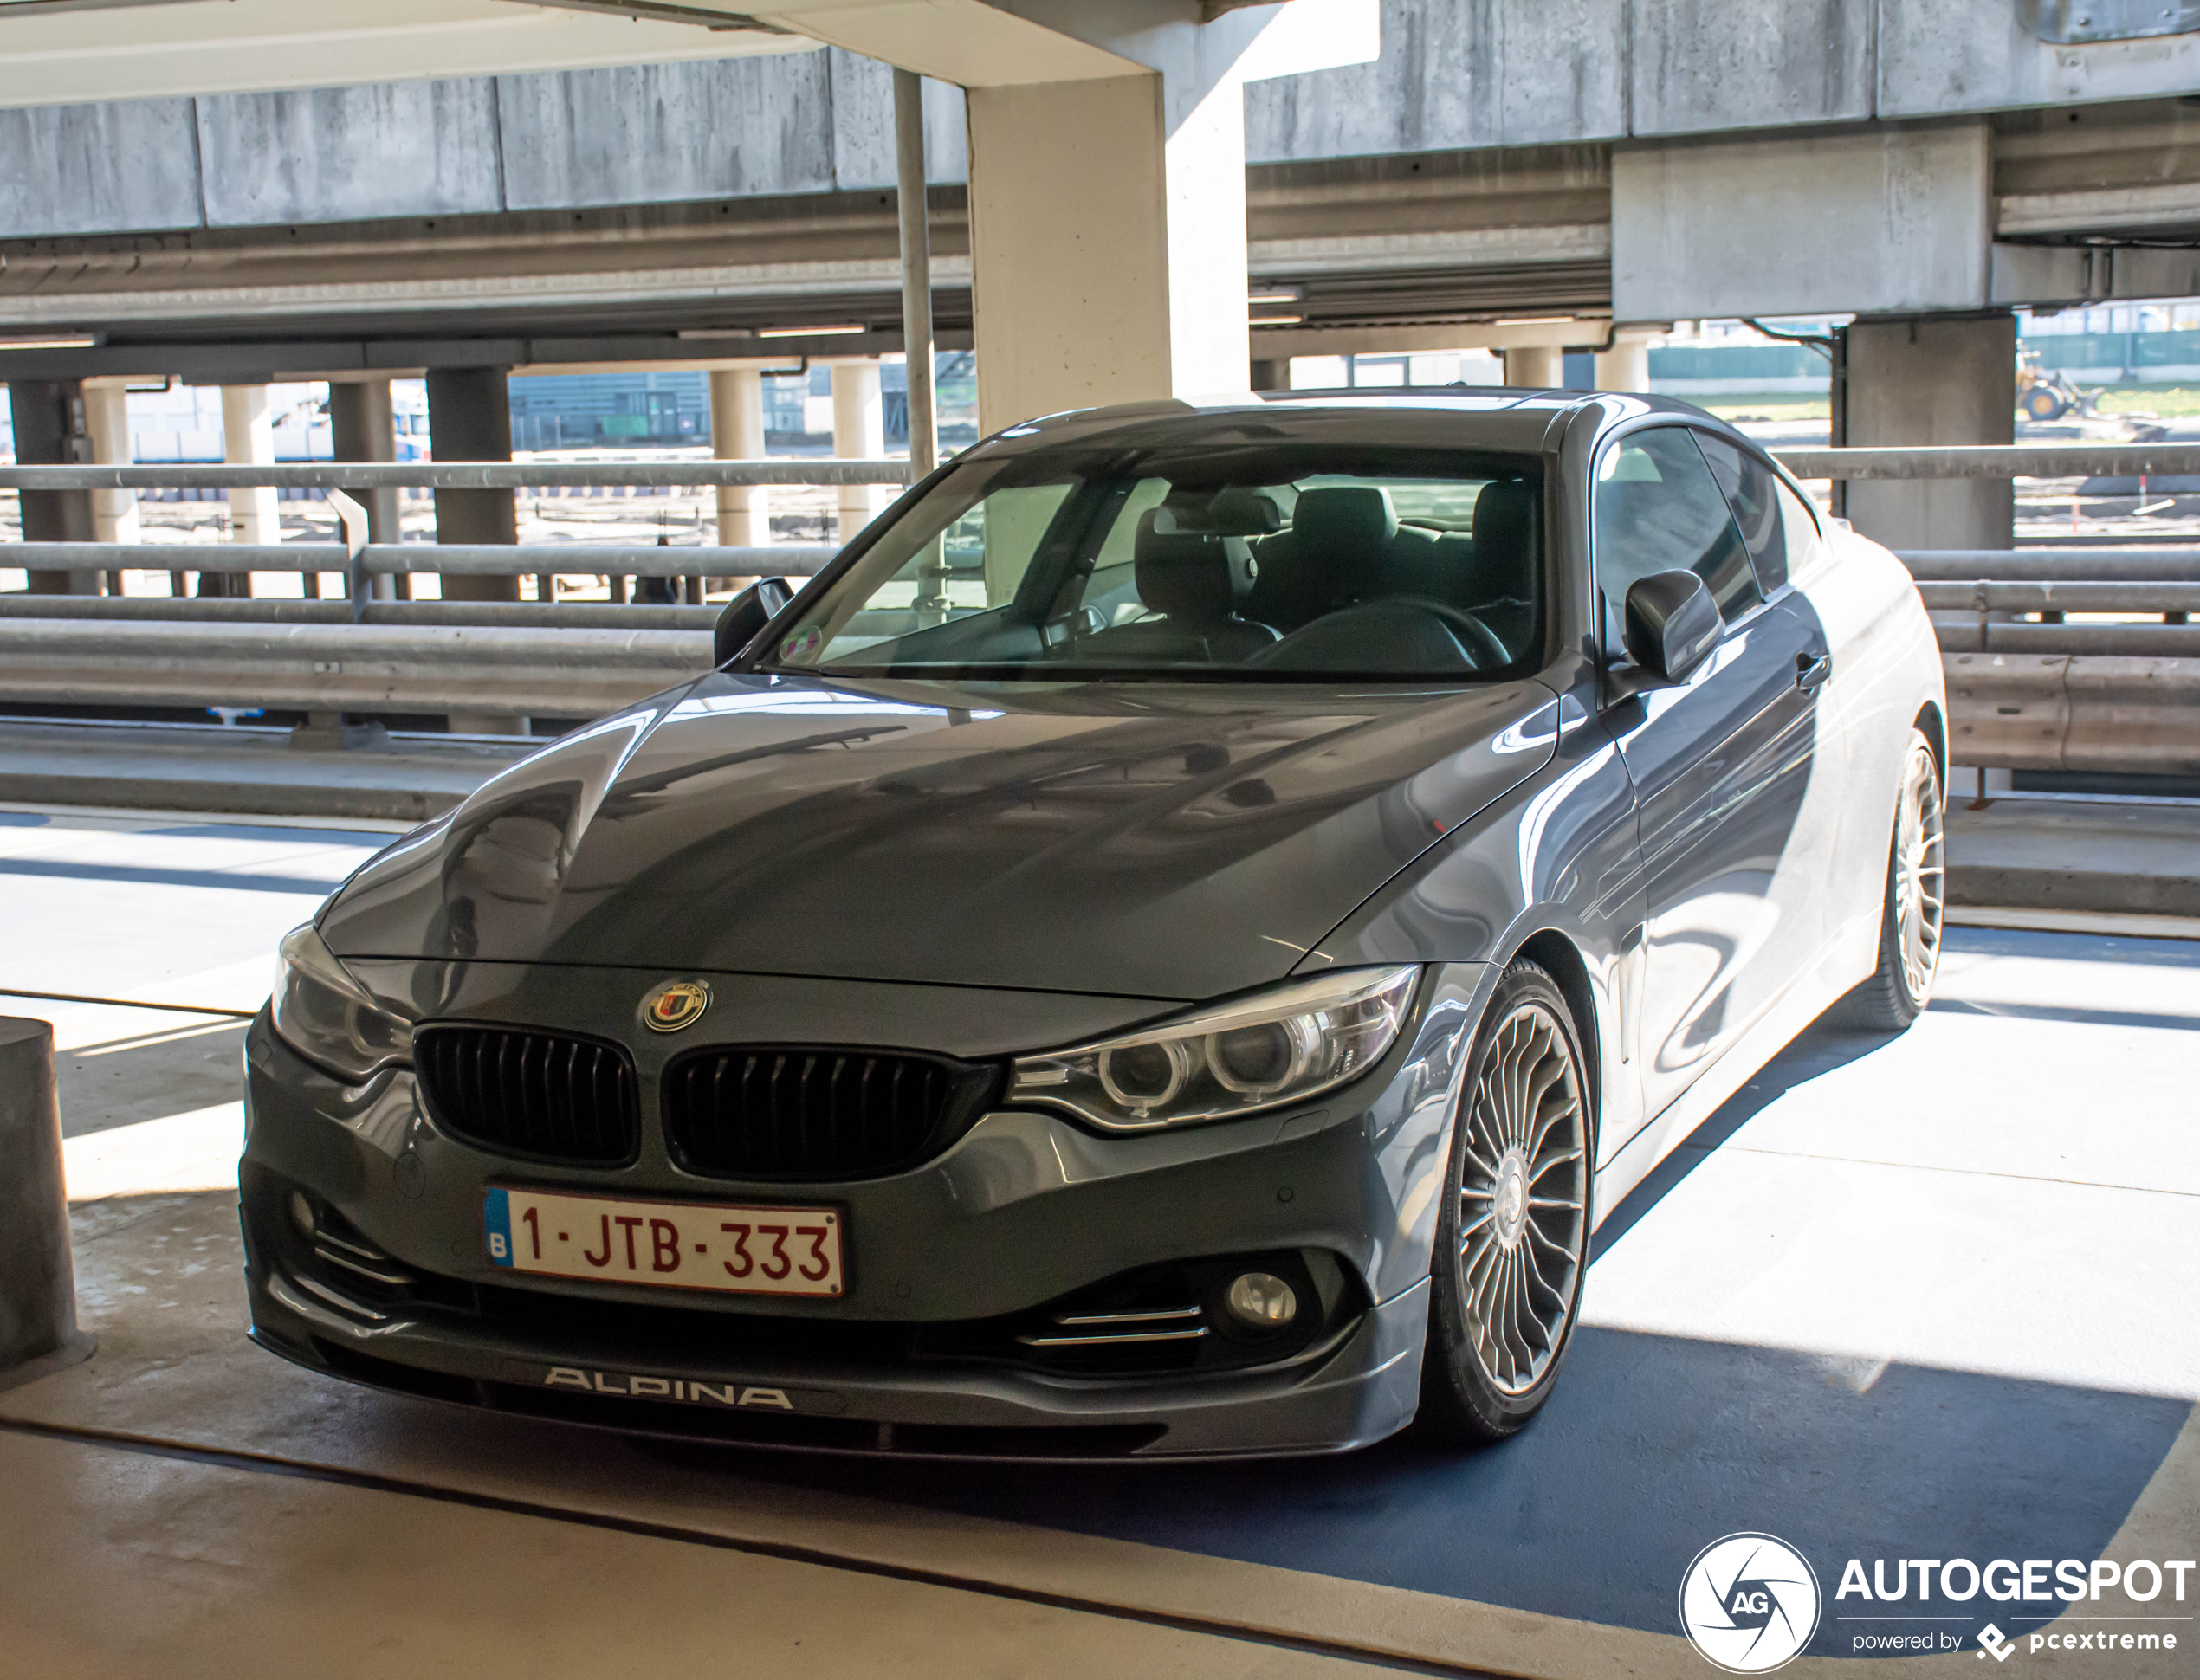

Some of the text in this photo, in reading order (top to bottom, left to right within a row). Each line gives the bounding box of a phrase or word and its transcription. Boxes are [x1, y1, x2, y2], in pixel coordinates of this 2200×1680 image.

[490, 1232, 507, 1257] B
[522, 1206, 831, 1282] 1-JTB-333
[544, 1367, 793, 1410] ALPINA
